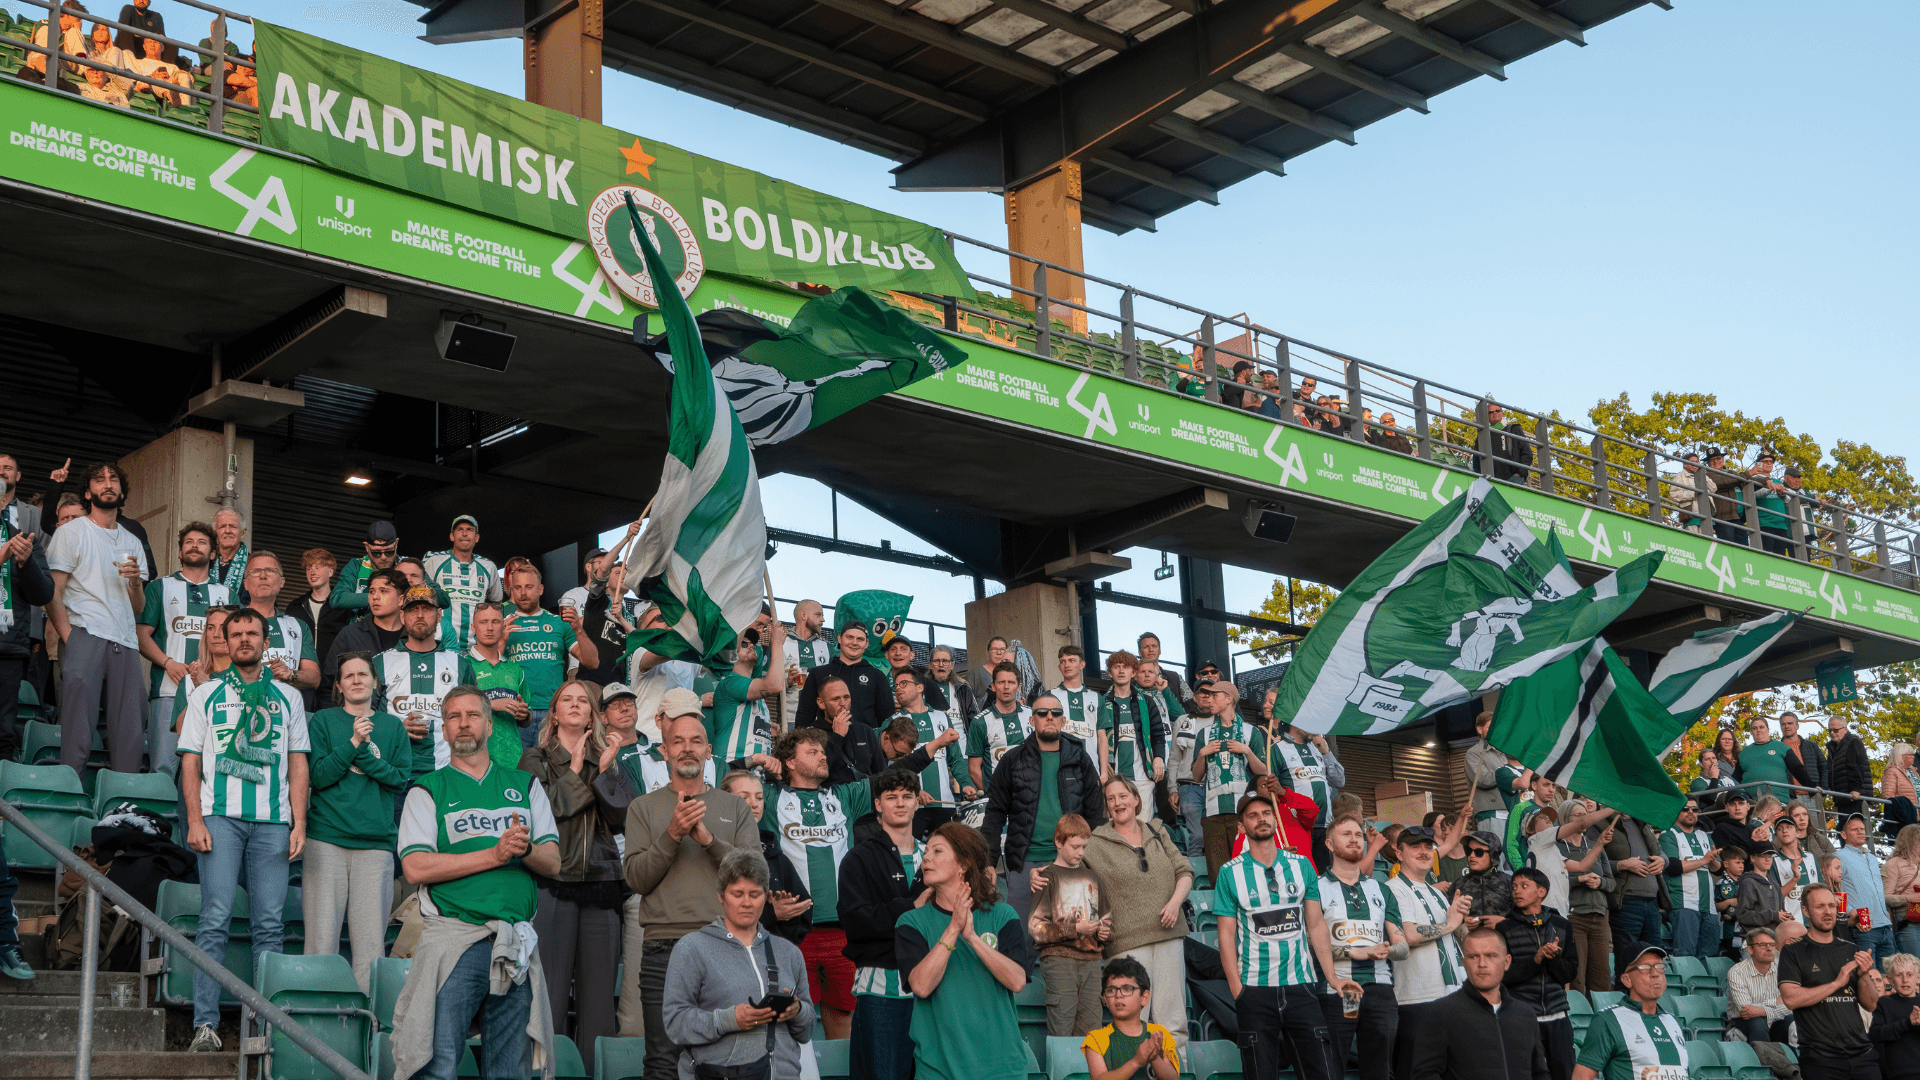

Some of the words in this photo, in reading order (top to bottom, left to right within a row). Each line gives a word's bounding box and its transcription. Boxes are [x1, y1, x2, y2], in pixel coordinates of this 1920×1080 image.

[30, 121, 82, 146] MAKE
[89, 136, 178, 172] FOOTBALL
[269, 71, 578, 206] AKADEMISK
[10, 131, 87, 162] DREAMS
[92, 153, 145, 177] COME
[150, 167, 196, 190] TRUE
[317, 216, 372, 239] unisport
[591, 189, 640, 259] AKADEMISK
[651, 197, 699, 283] BOLDKLUB
[702, 197, 935, 270] BOLDKLUB
[407, 220, 449, 242] MAKE
[454, 232, 526, 262] FOOTBALL
[391, 229, 453, 256] DREAMS
[457, 247, 500, 269] COME
[505, 258, 541, 278] TRUE
[635, 286, 659, 303] 18
[753, 308, 792, 329] FOOTB
[956, 372, 999, 393] DREAMS
[1001, 384, 1031, 401] COME
[1033, 392, 1060, 408] TRUE
[966, 364, 996, 381] MAKE
[999, 372, 1049, 395] FOOTBALL
[1128, 420, 1161, 436] unisport
[1179, 419, 1204, 434] MAKE
[1206, 426, 1249, 446] FOOTBALL
[1171, 427, 1208, 445] DREAMS
[1209, 437, 1235, 452] COME
[1237, 444, 1258, 458] TRUE
[1316, 468, 1344, 482] unisport
[1358, 466, 1381, 479] MAKE
[1382, 472, 1419, 489] FOOTBALL
[1352, 473, 1383, 489] DREAMS
[1385, 482, 1407, 496] COME
[1408, 487, 1428, 501] TRUE
[1514, 506, 1534, 518] MAKE
[1535, 510, 1568, 527] FOOTBALL
[1558, 527, 1575, 538] TRUE
[1618, 544, 1640, 556] unisport
[1649, 541, 1666, 551] MAKE
[1667, 546, 1696, 560] FOOTBALL
[1501, 542, 1566, 600] HENRI
[1669, 555, 1688, 566] COME
[1688, 559, 1703, 570] TRUE
[1741, 576, 1761, 587] unisport
[1765, 579, 1788, 591] DREAMS
[1788, 585, 1804, 595] COME
[1804, 589, 1817, 599] TRUE
[1769, 572, 1785, 583] MAKE
[1785, 577, 1811, 589] FOOTBALL
[509, 652, 557, 663] WORKWEAR
[392, 694, 442, 714] Carlsber
[1372, 700, 1398, 713] 1988
[783, 822, 845, 840] Carlsberg
[1331, 921, 1383, 942] Carlsberg
